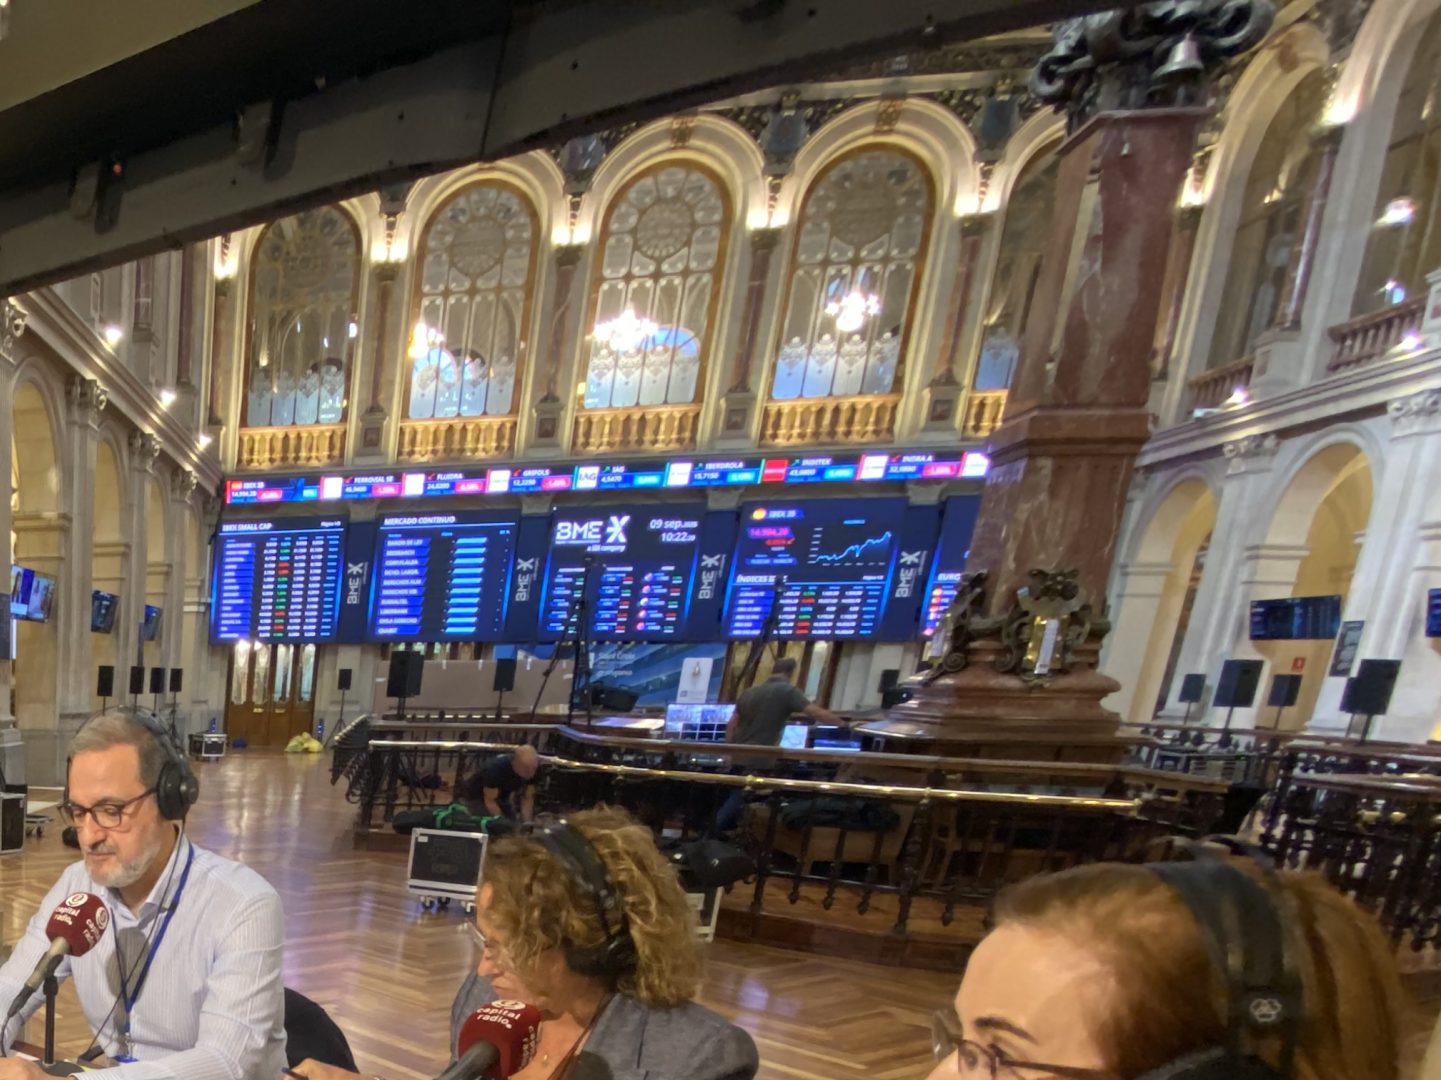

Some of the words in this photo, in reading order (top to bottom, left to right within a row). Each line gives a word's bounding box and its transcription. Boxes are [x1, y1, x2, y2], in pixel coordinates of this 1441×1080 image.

[383, 517, 417, 525] MERCADO
[418, 516, 456, 524] CONTINUO
[555, 521, 604, 540] BME
[476, 1007, 521, 1021] capital
